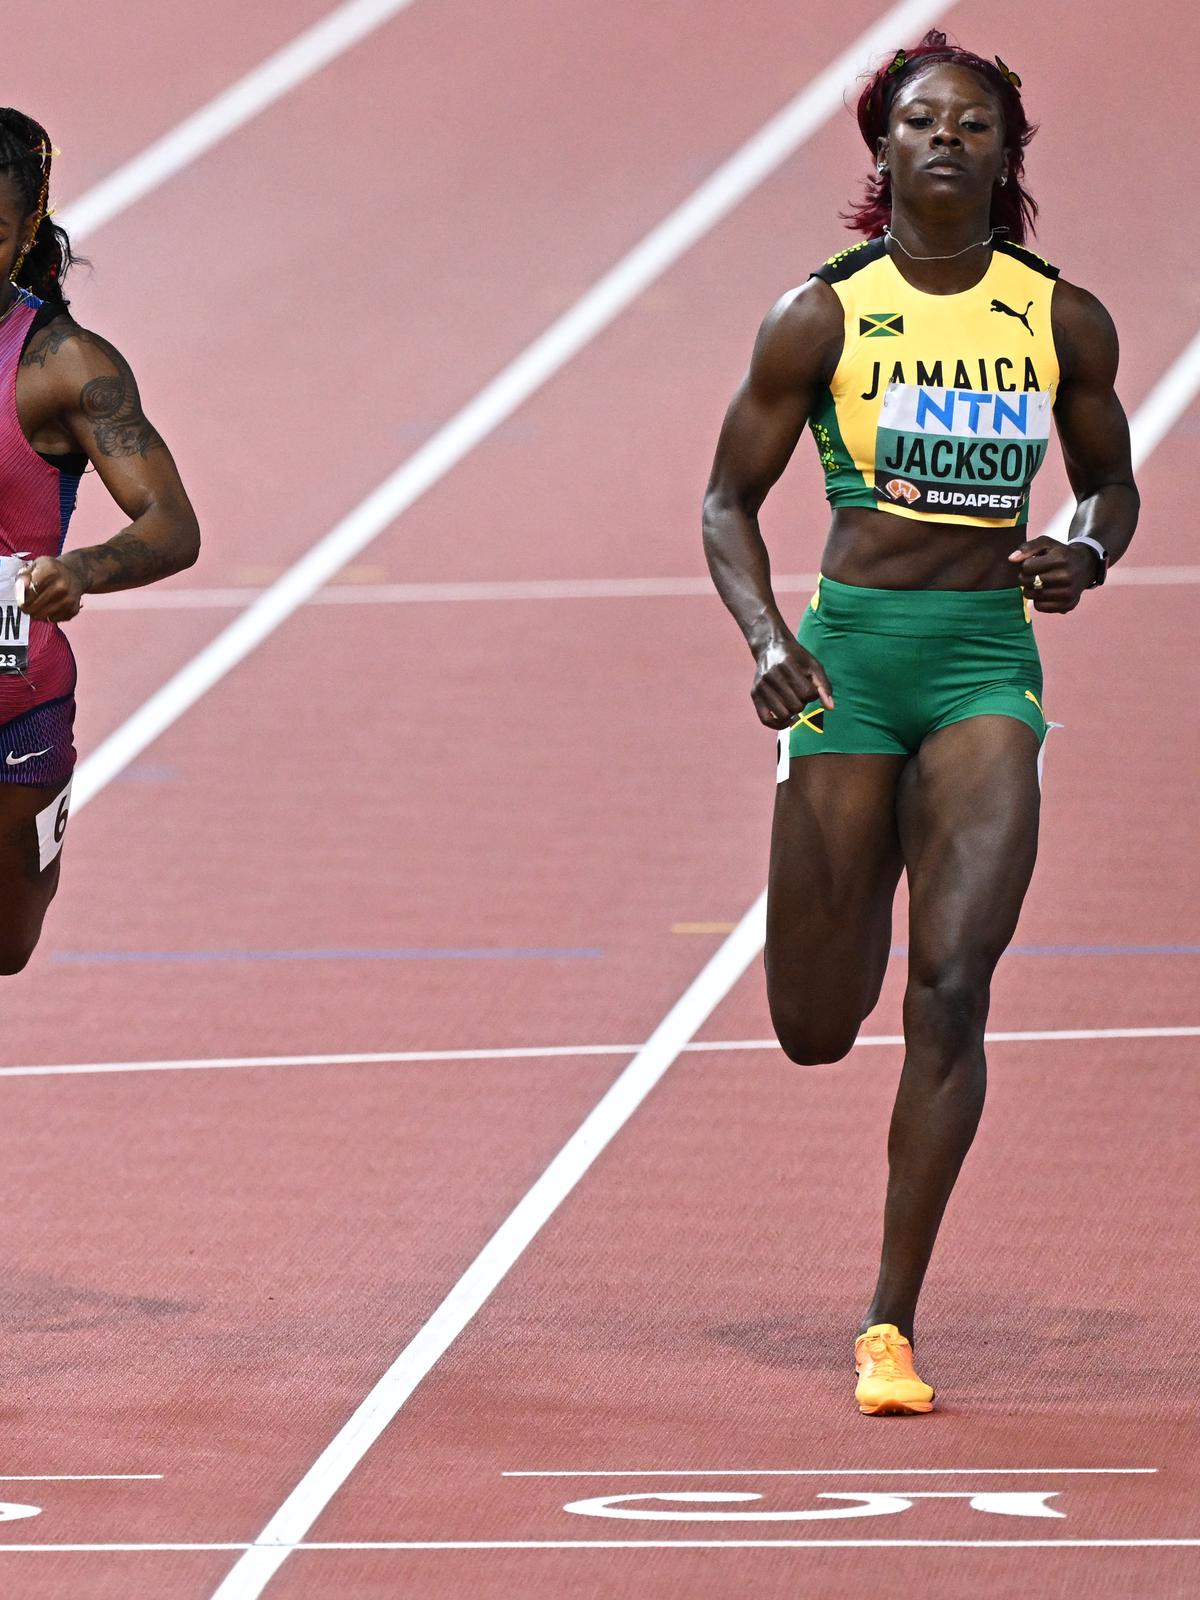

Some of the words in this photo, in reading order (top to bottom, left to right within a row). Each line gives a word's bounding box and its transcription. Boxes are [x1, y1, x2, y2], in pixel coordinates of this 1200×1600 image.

[861, 356, 1040, 401] JAMAICA
[915, 388, 1027, 435] NTN
[885, 436, 1042, 484] JACKSON
[926, 490, 1021, 509] BUDAPEST
[54, 795, 68, 843] 6
[563, 1492, 1067, 1521] 5
